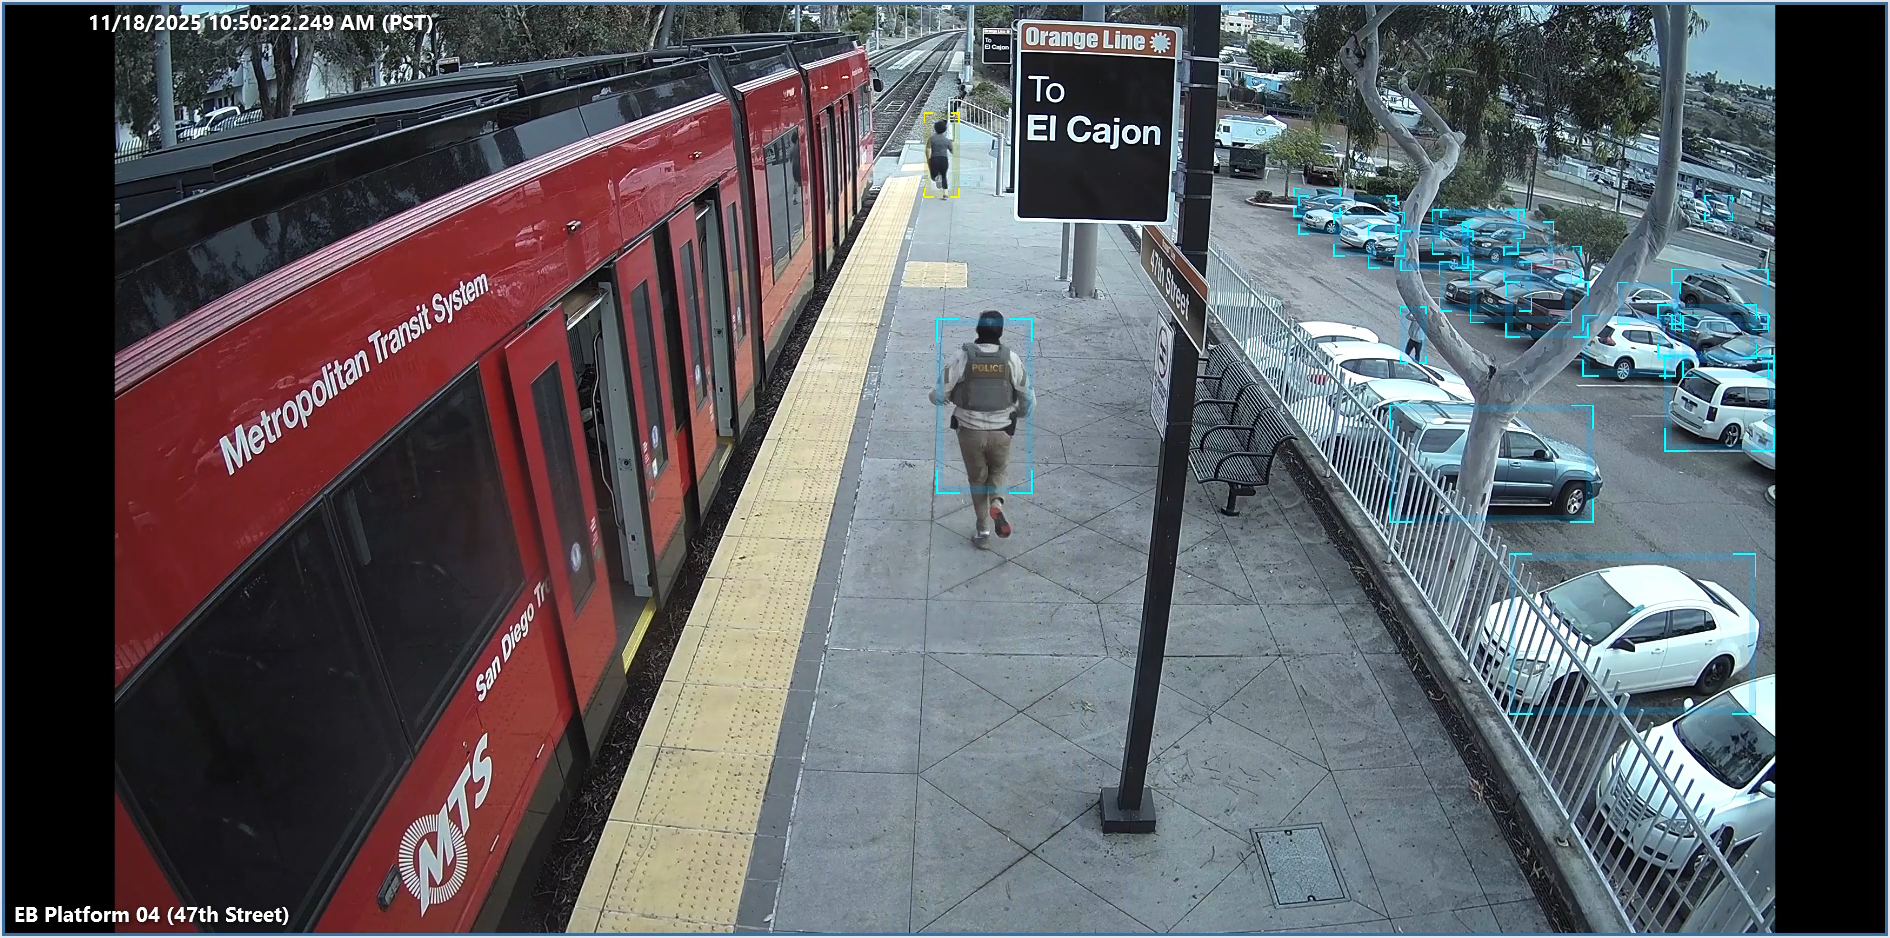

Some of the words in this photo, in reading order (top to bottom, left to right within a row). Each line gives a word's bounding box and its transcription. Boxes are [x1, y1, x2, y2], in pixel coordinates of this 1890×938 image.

[1025, 26, 1099, 50] Orange
[1102, 29, 1146, 51] Line
[1027, 75, 1066, 103] To
[1026, 114, 1057, 142] El
[1066, 115, 1161, 150] Cajon
[1150, 248, 1165, 287] 47th
[1165, 267, 1190, 322] Street
[218, 349, 370, 475] Metropolitan
[367, 304, 432, 364] Transit
[431, 273, 489, 323] System
[971, 363, 1005, 373] POLICE
[475, 655, 502, 702] San
[501, 602, 535, 663] Diego
[420, 732, 493, 918] MTS
